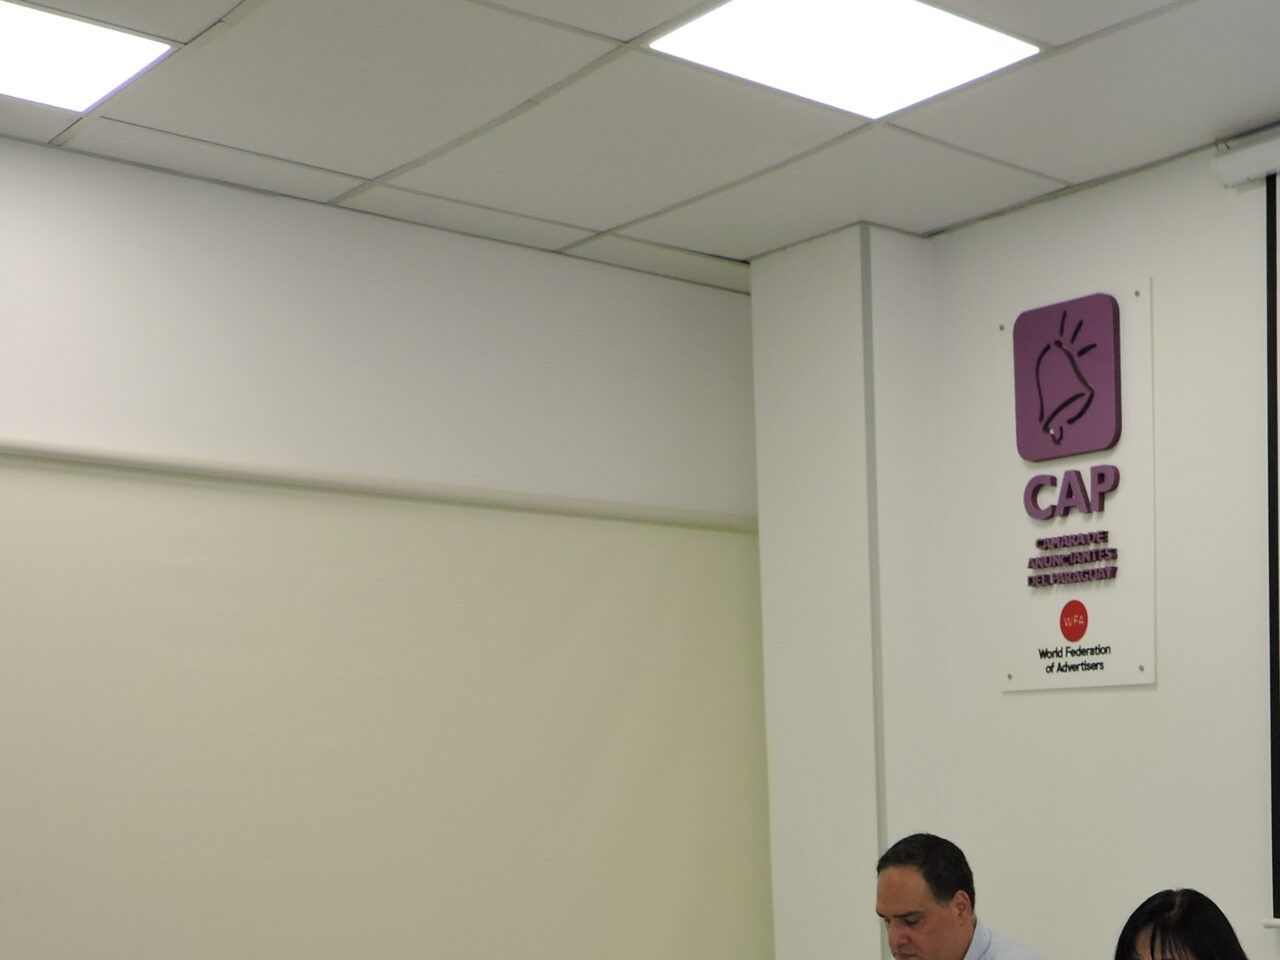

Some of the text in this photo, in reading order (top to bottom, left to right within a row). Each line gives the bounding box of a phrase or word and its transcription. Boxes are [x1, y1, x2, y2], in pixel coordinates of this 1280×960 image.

[1023, 464, 1121, 520] CAP
[1089, 531, 1109, 545] DE
[1027, 548, 1118, 569] ANUNCIANTES
[1027, 566, 1118, 588] DEL PARAGUAY
[1063, 615, 1085, 627] WFA
[1038, 644, 1111, 660] World Federation
[1045, 661, 1104, 674] of Advertisers
